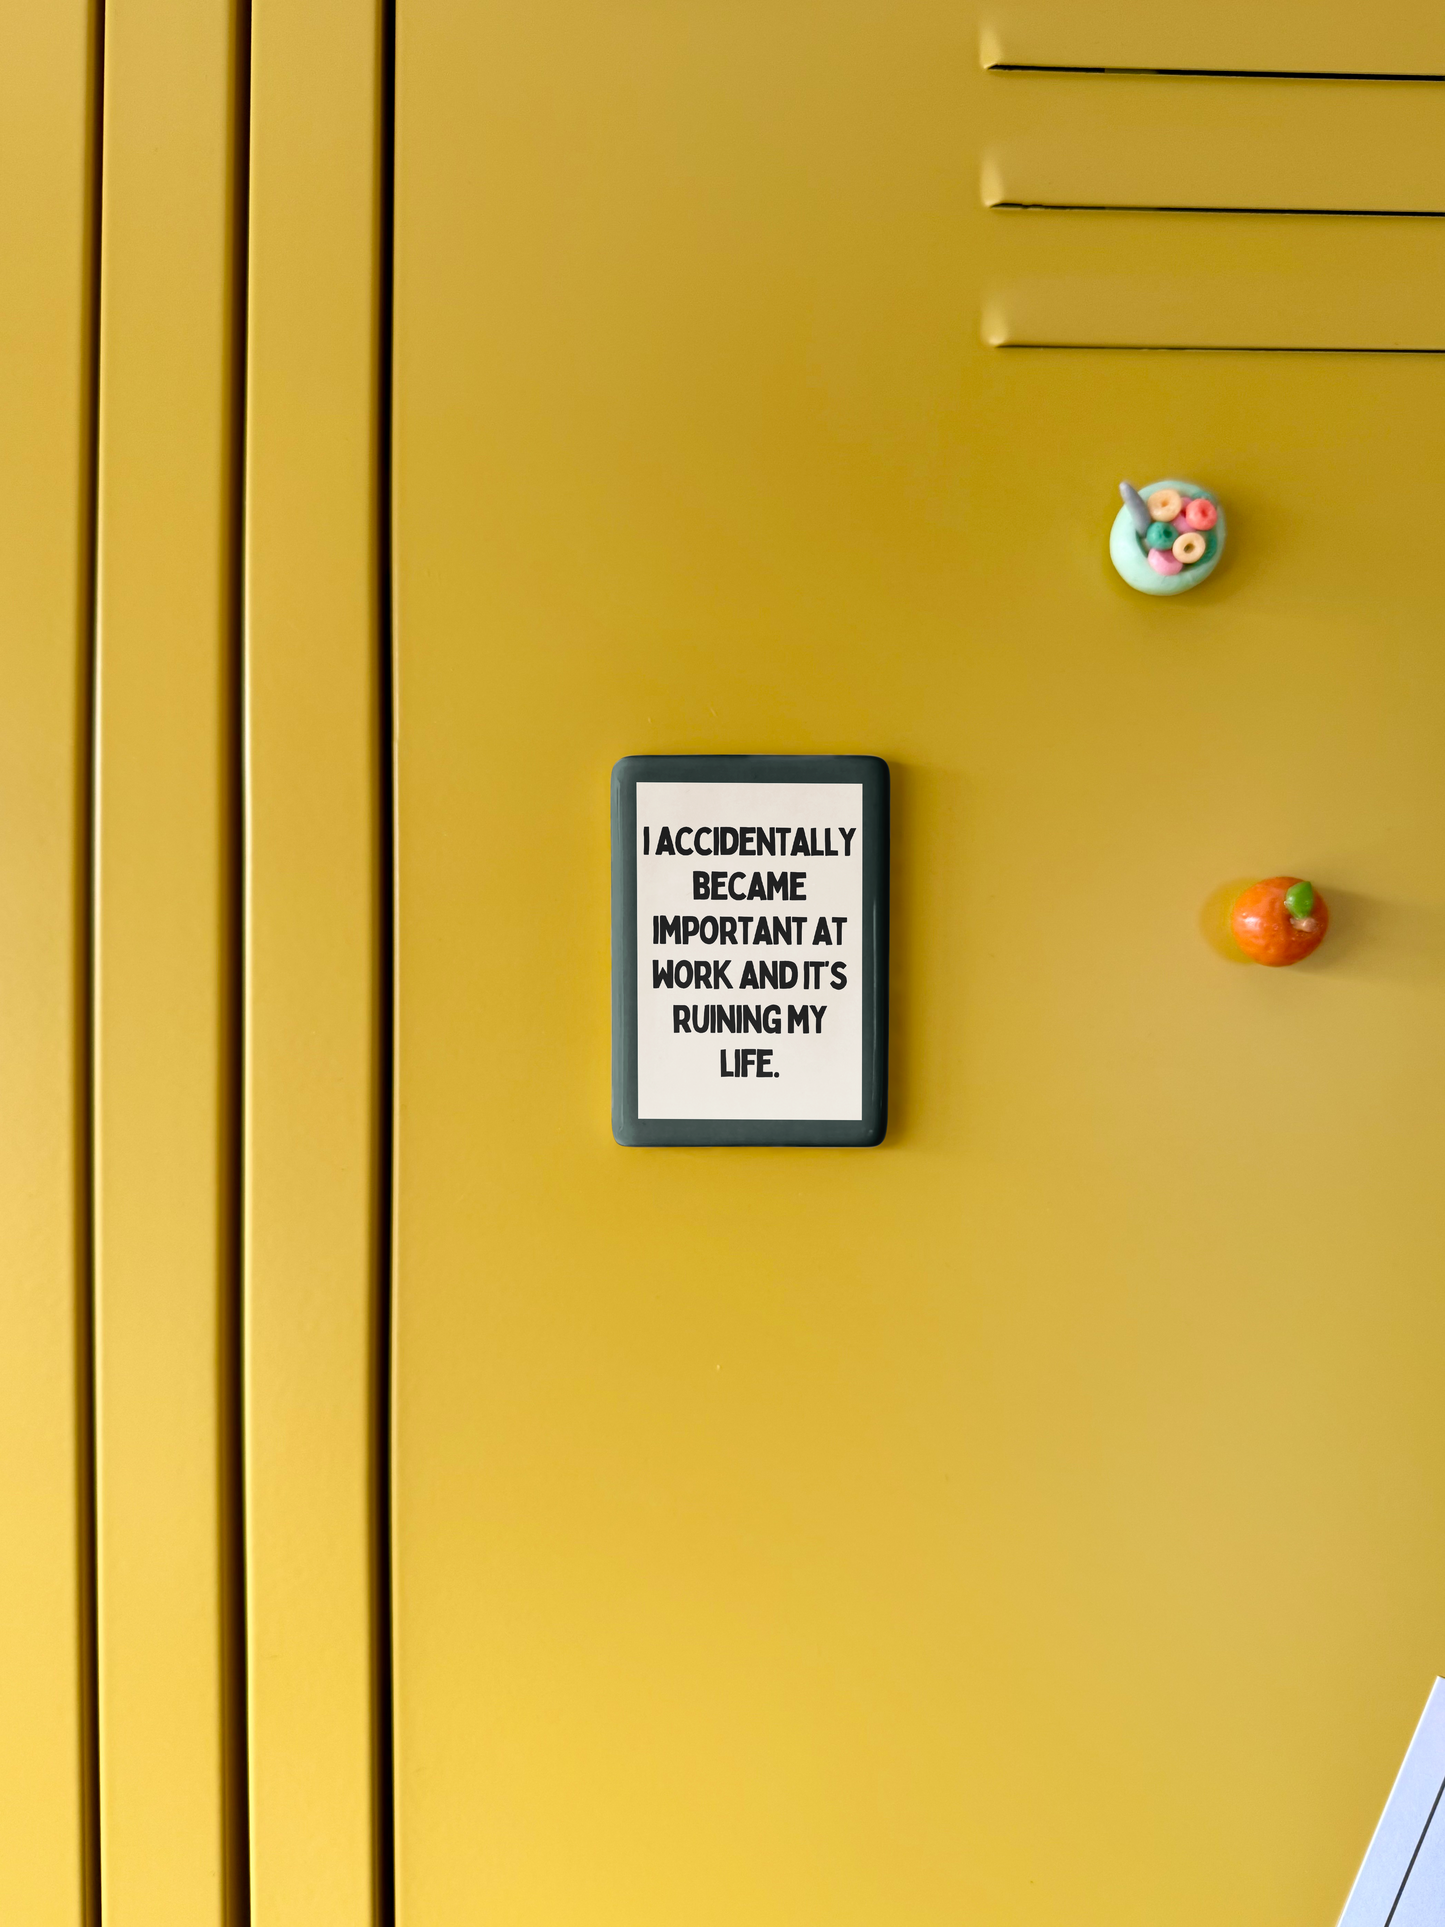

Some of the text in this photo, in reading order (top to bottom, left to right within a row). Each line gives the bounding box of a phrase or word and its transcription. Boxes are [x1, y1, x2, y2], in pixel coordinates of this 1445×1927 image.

[644, 827, 856, 856] I ACCIDENTALLY
[693, 871, 807, 900] BECAME
[653, 915, 847, 945] IMPORTANT AT
[653, 960, 847, 990] WORK AND IT'S
[673, 1005, 827, 1034] RUINING MY
[721, 1049, 779, 1078] LIFE.
